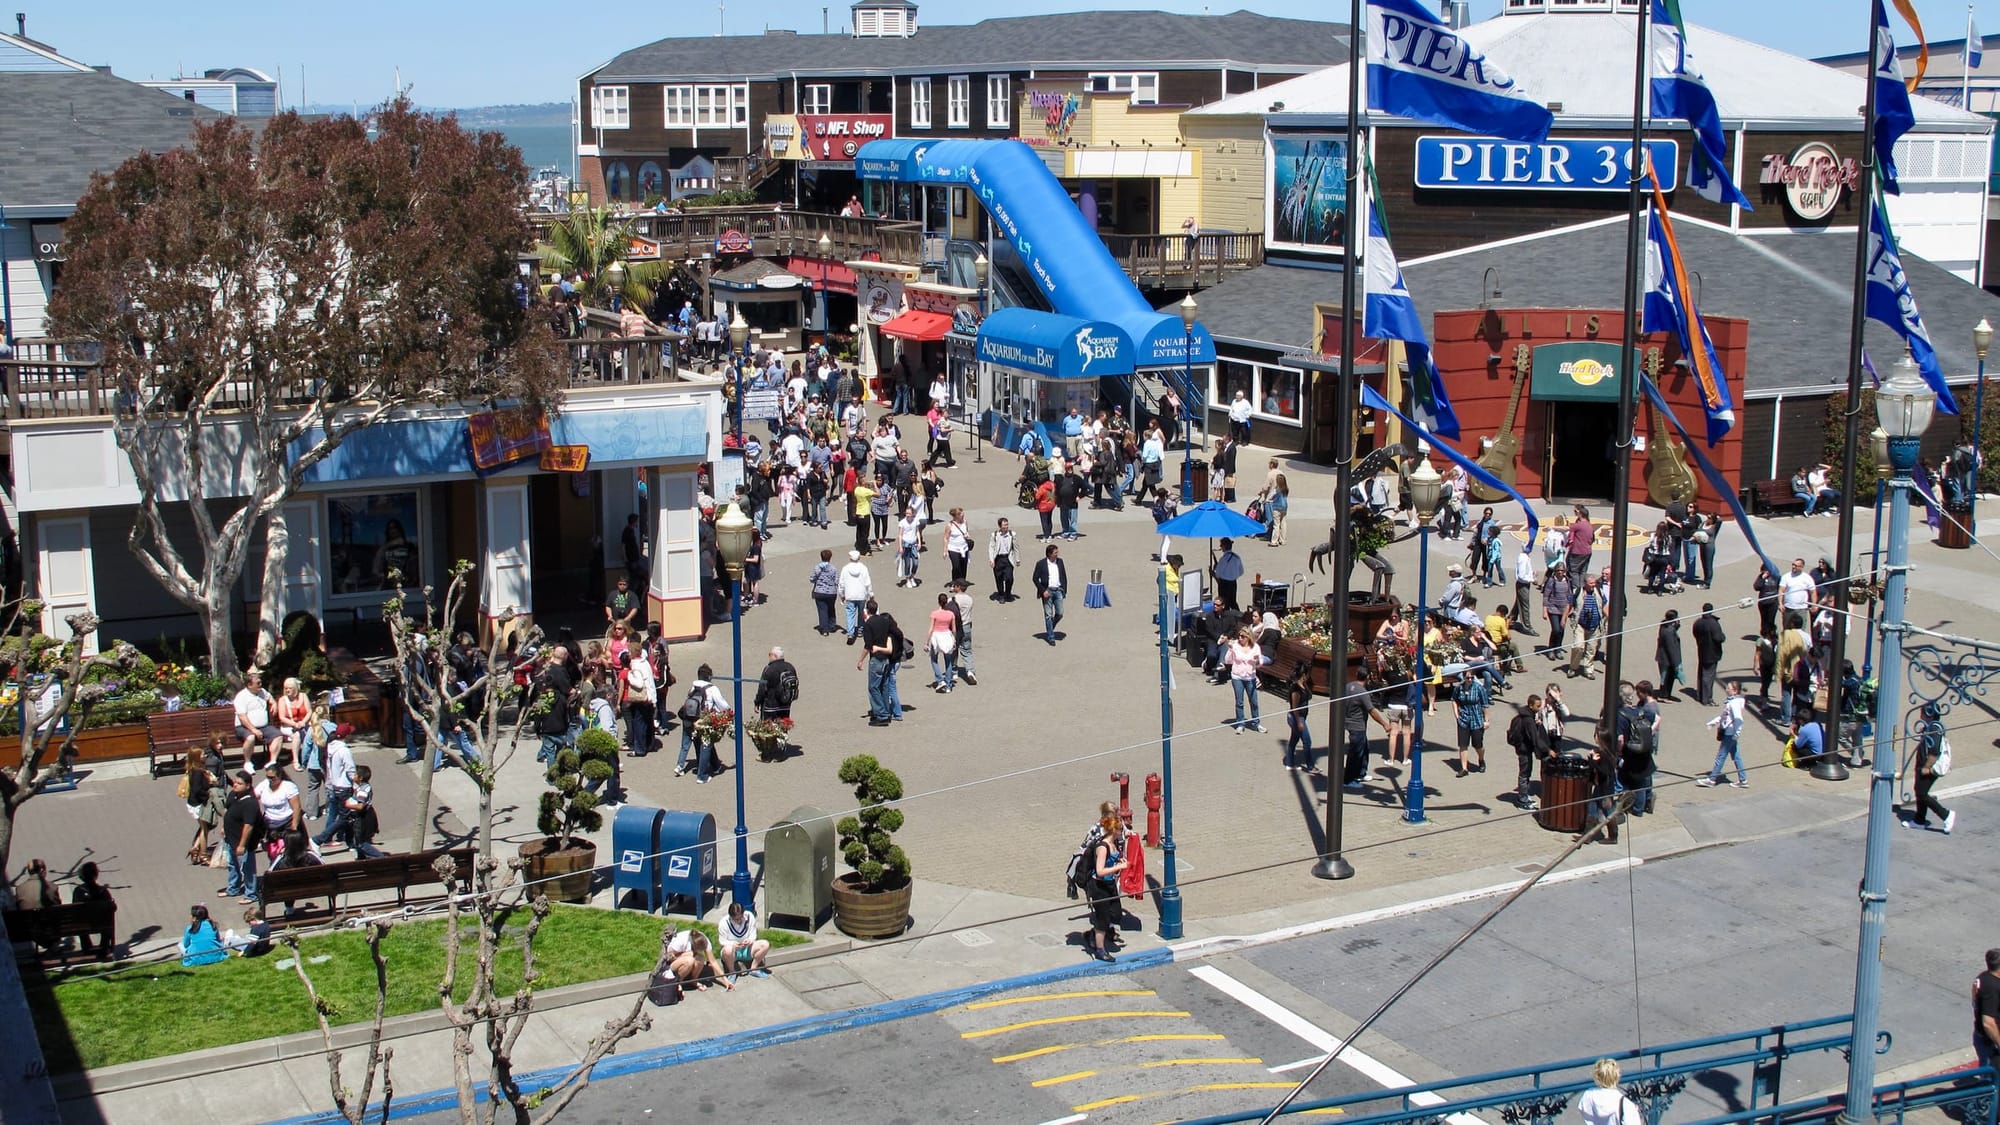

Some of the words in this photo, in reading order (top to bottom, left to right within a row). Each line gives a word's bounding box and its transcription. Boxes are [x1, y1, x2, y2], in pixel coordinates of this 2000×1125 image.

[1381, 13, 1489, 84] PIER
[828, 121, 850, 136] NFL
[853, 120, 885, 137] Shop
[1438, 143, 1574, 183] PIER
[1760, 154, 1815, 185] Hard
[1814, 156, 1860, 192] Rock
[995, 202, 1009, 225] 20,000
[1006, 220, 1018, 237] Fish
[1033, 257, 1046, 278] Touch
[1044, 275, 1056, 292] Pool
[1566, 314, 1601, 335] IS
[981, 337, 1022, 361] AQUARIUM
[1036, 347, 1054, 369] BAY
[1086, 336, 1119, 348] AQUARIUM
[1094, 346, 1118, 359] BAY
[1559, 361, 1586, 375] Hard
[1587, 363, 1614, 378] Rock
